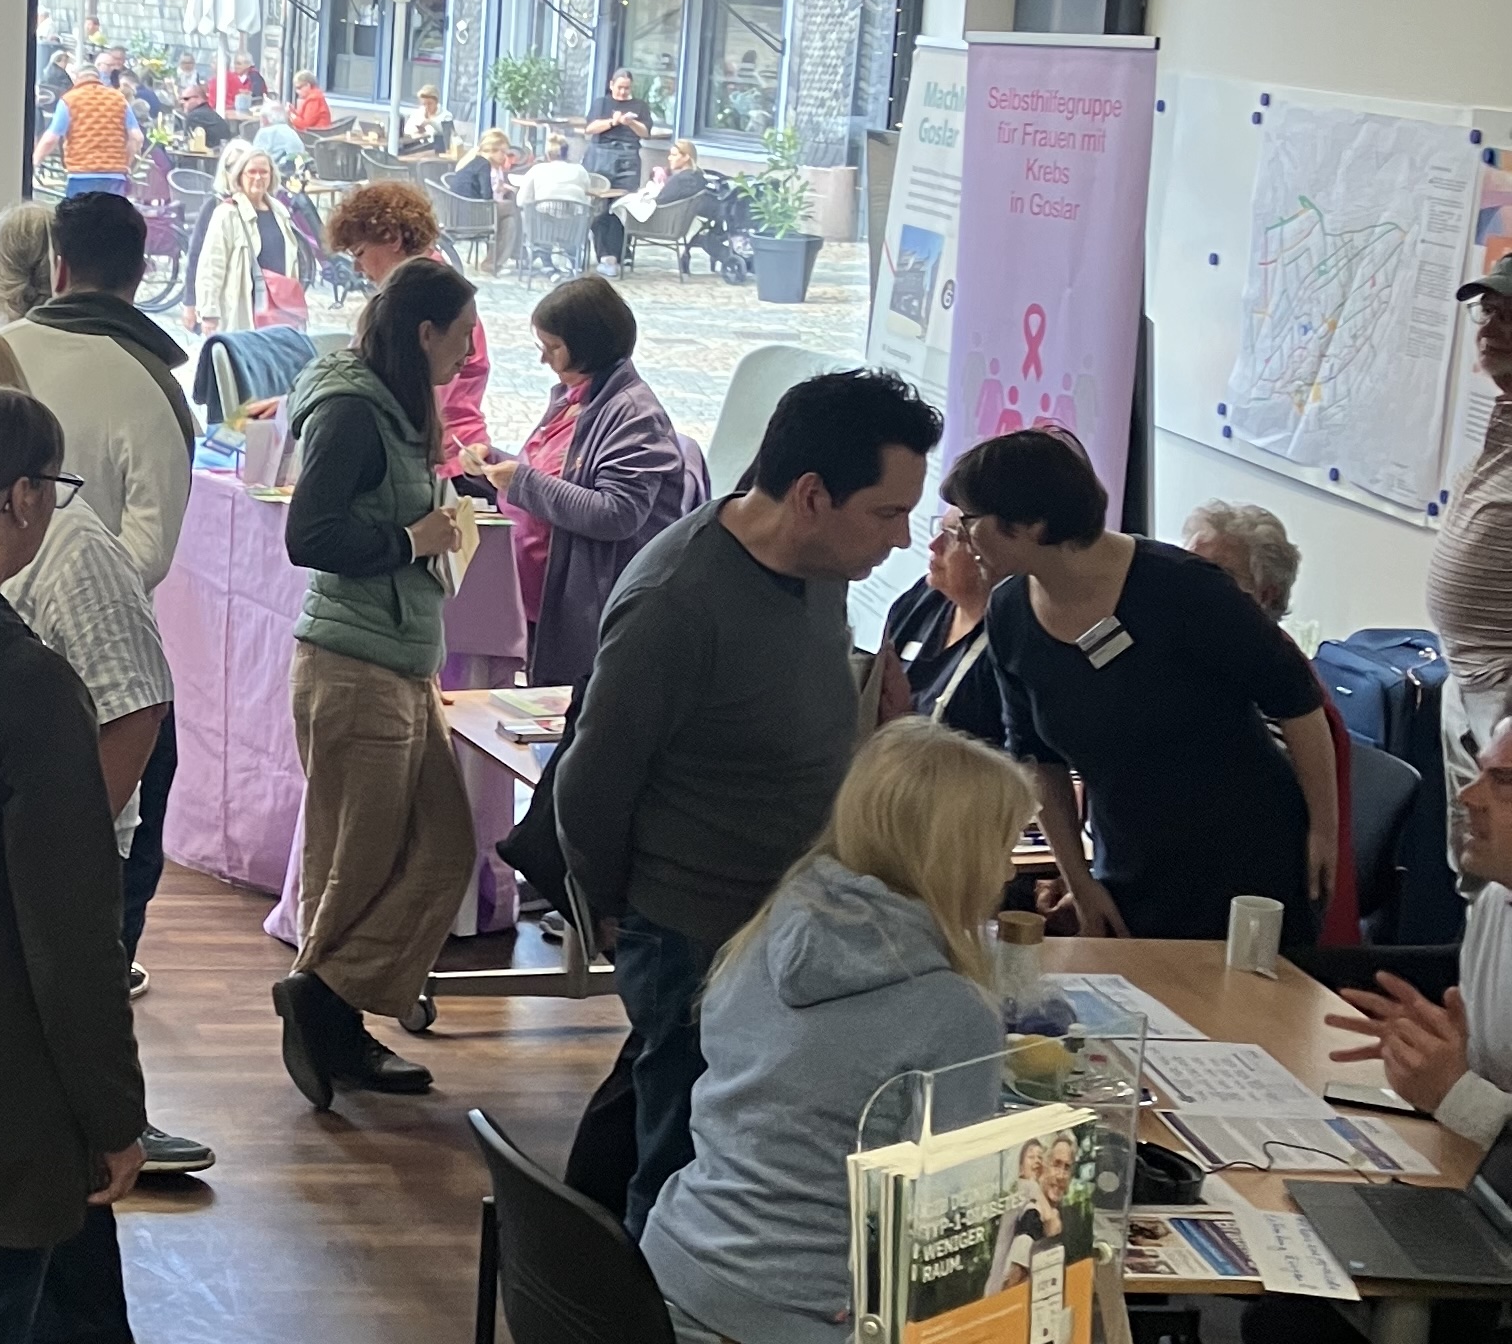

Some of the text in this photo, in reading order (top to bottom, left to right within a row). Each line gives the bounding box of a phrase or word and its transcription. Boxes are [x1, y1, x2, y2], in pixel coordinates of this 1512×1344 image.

[987, 86, 1123, 123] Selbsthilfegruppe
[918, 116, 960, 148] Goslar
[997, 120, 1107, 153] für Frauen mit
[1025, 157, 1070, 184] Krebs
[1009, 190, 1081, 221] in Goslar
[922, 1226, 986, 1262] WENIGER
[922, 1254, 965, 1284] RAUM.
